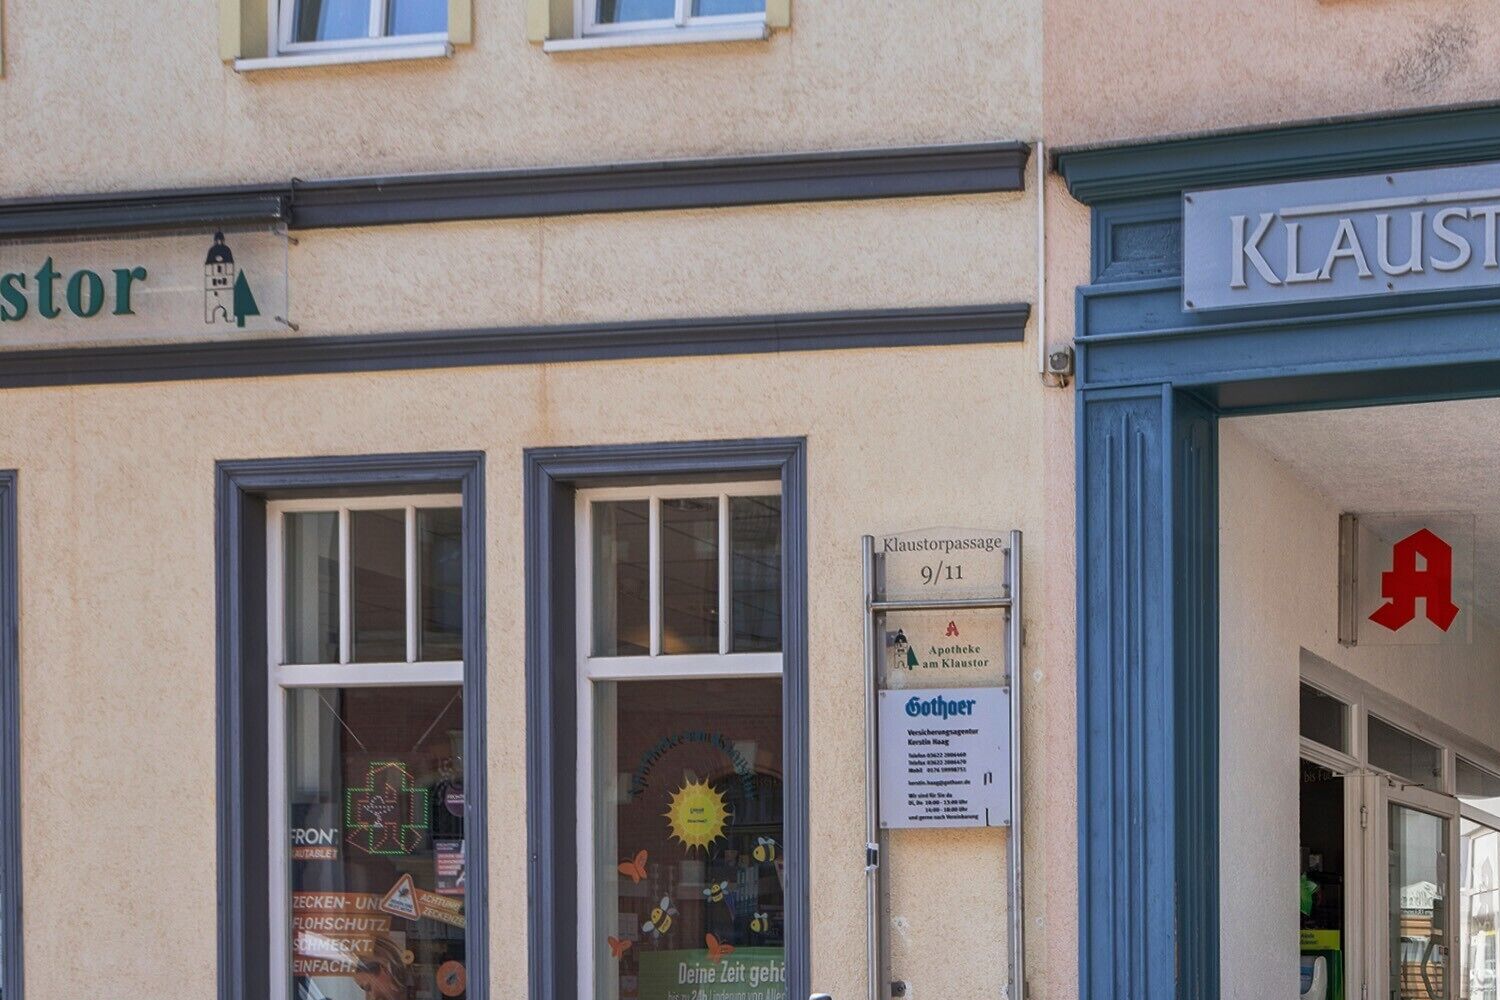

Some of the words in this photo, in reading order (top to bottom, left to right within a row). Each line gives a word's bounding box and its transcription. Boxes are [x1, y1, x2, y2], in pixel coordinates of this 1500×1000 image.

[883, 537, 1002, 554] Klaustorpassage
[921, 561, 963, 585] 9/11
[929, 645, 980, 656] Apotheke
[942, 658, 989, 668] Klaustor
[905, 695, 976, 720] Gothaer
[293, 896, 351, 909] ZECKEN-
[679, 962, 716, 985] Deine
[720, 960, 745, 983] Zeit
